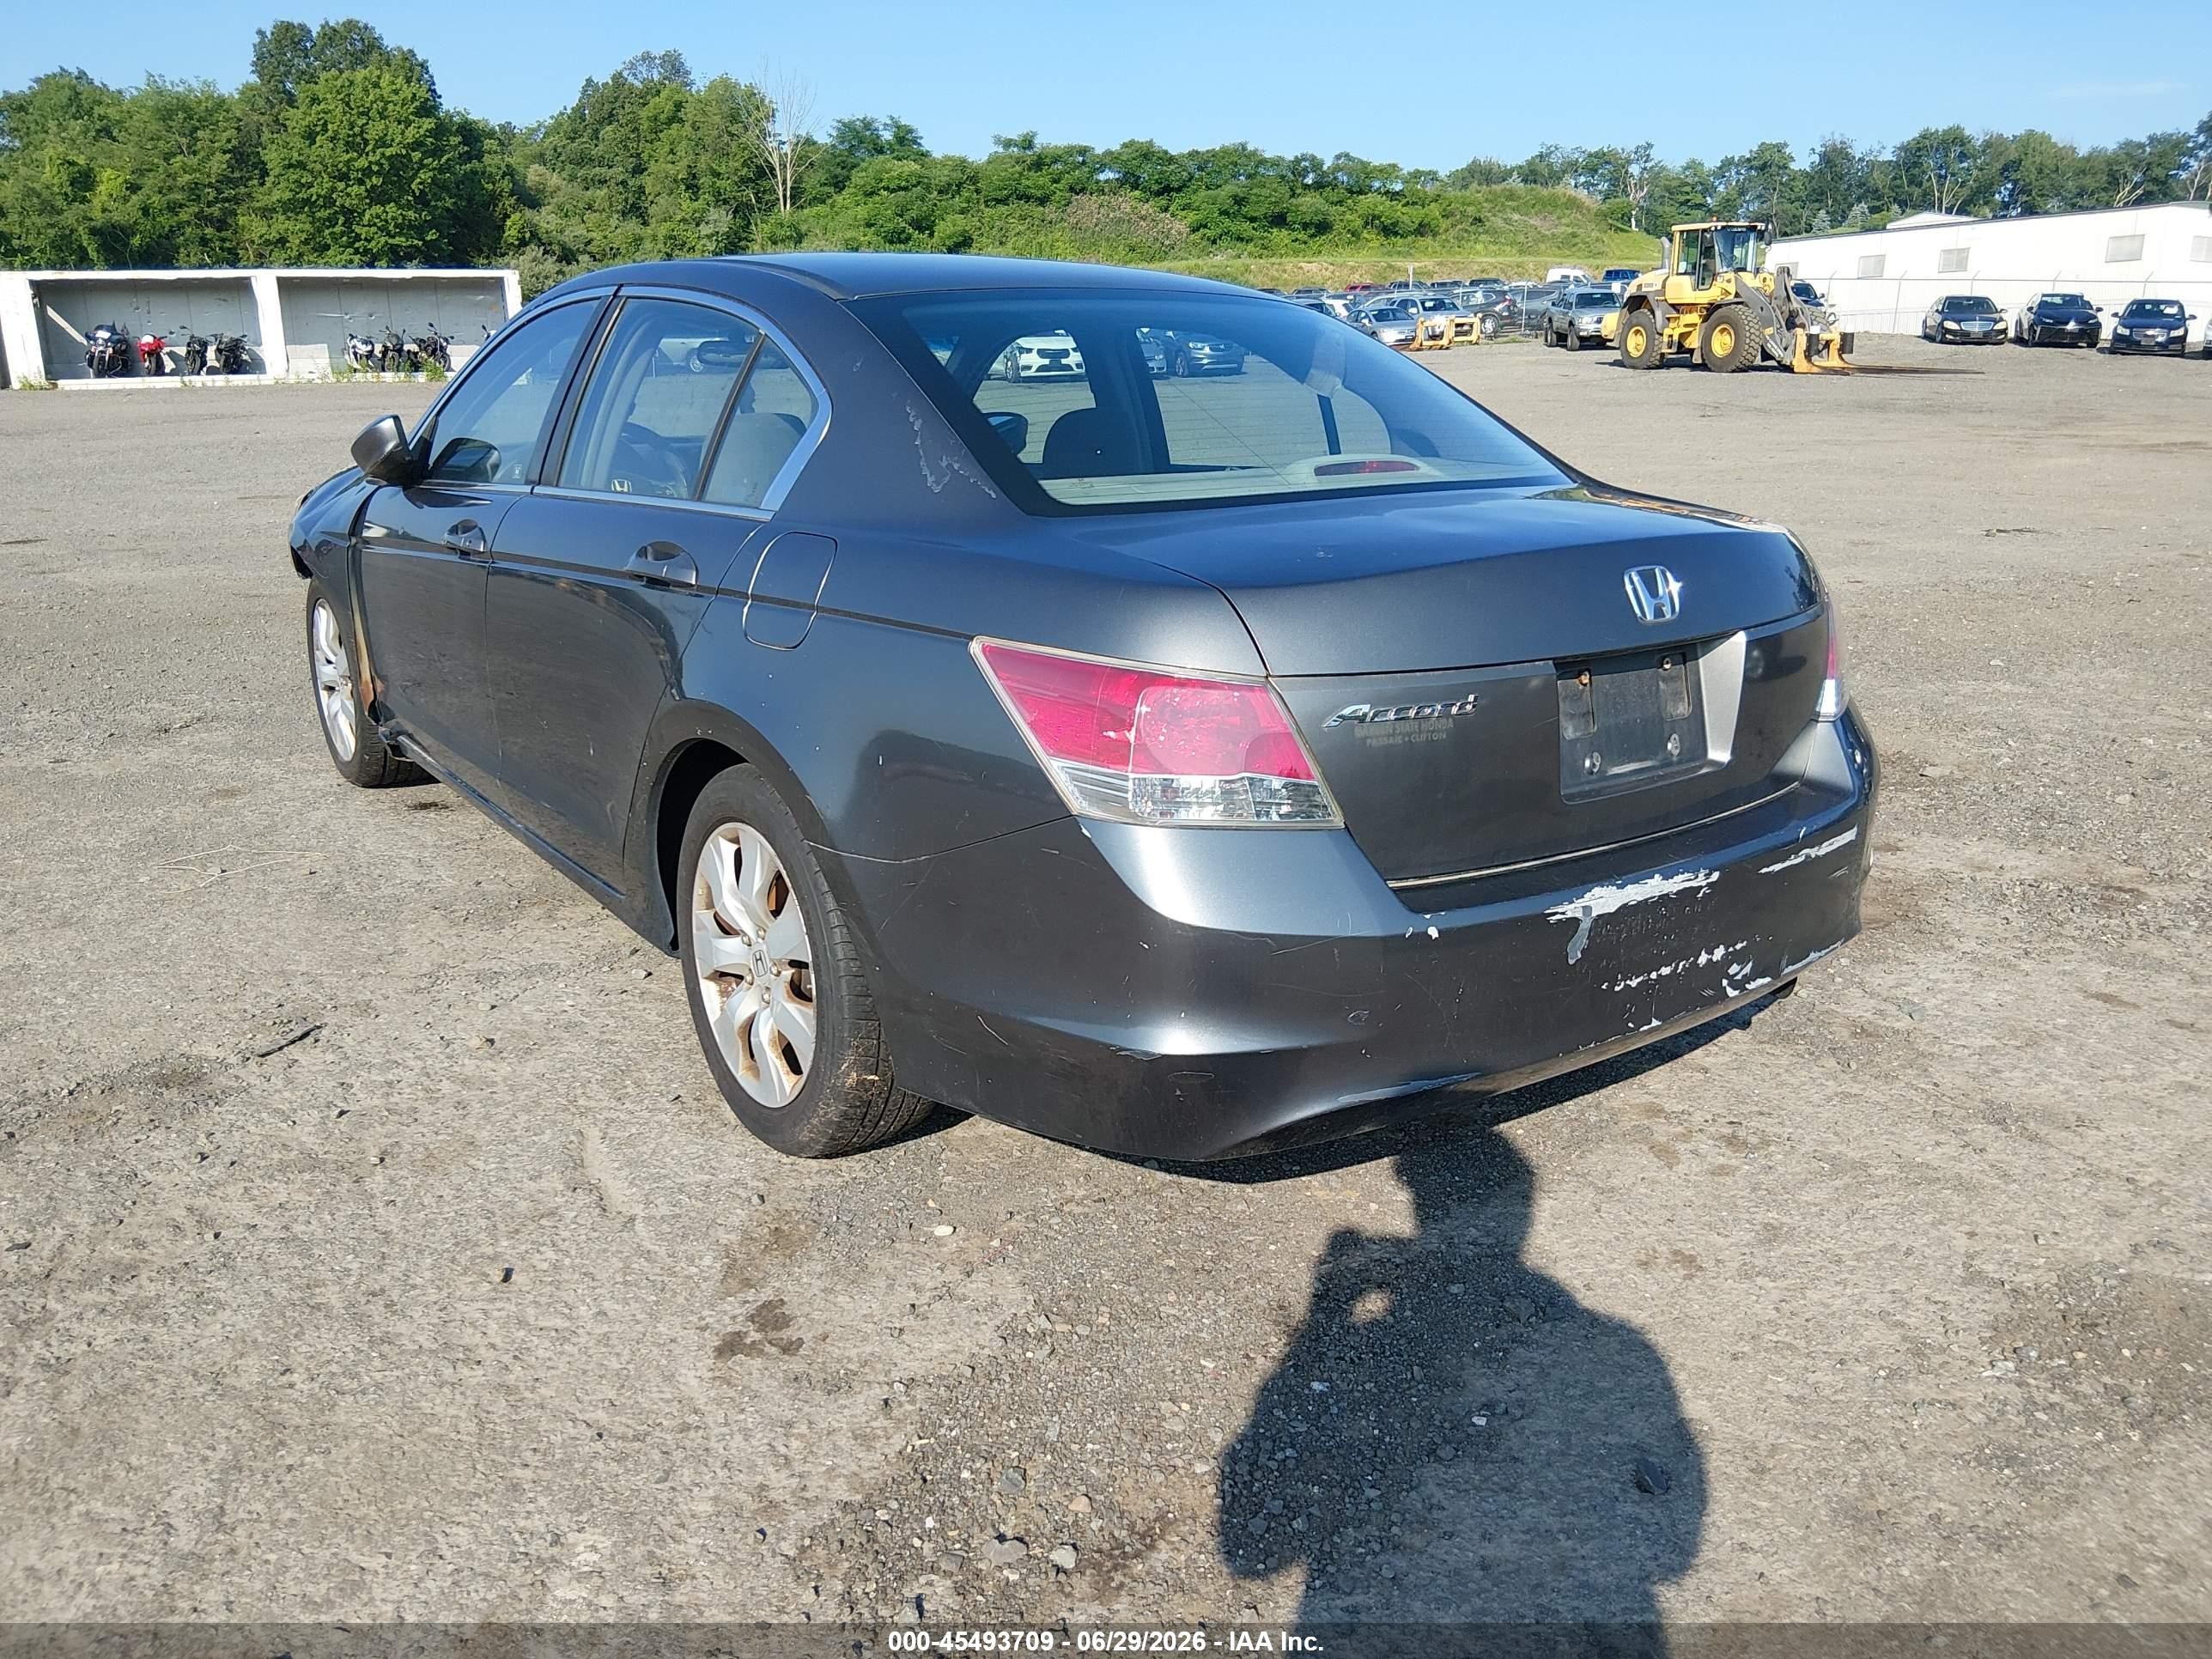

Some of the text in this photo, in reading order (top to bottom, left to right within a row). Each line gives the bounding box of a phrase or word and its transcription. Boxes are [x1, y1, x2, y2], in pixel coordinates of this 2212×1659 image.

[1322, 694, 1479, 728] Accord
[1421, 717, 1454, 732] HONDA
[1410, 732, 1447, 743] CLIFTON
